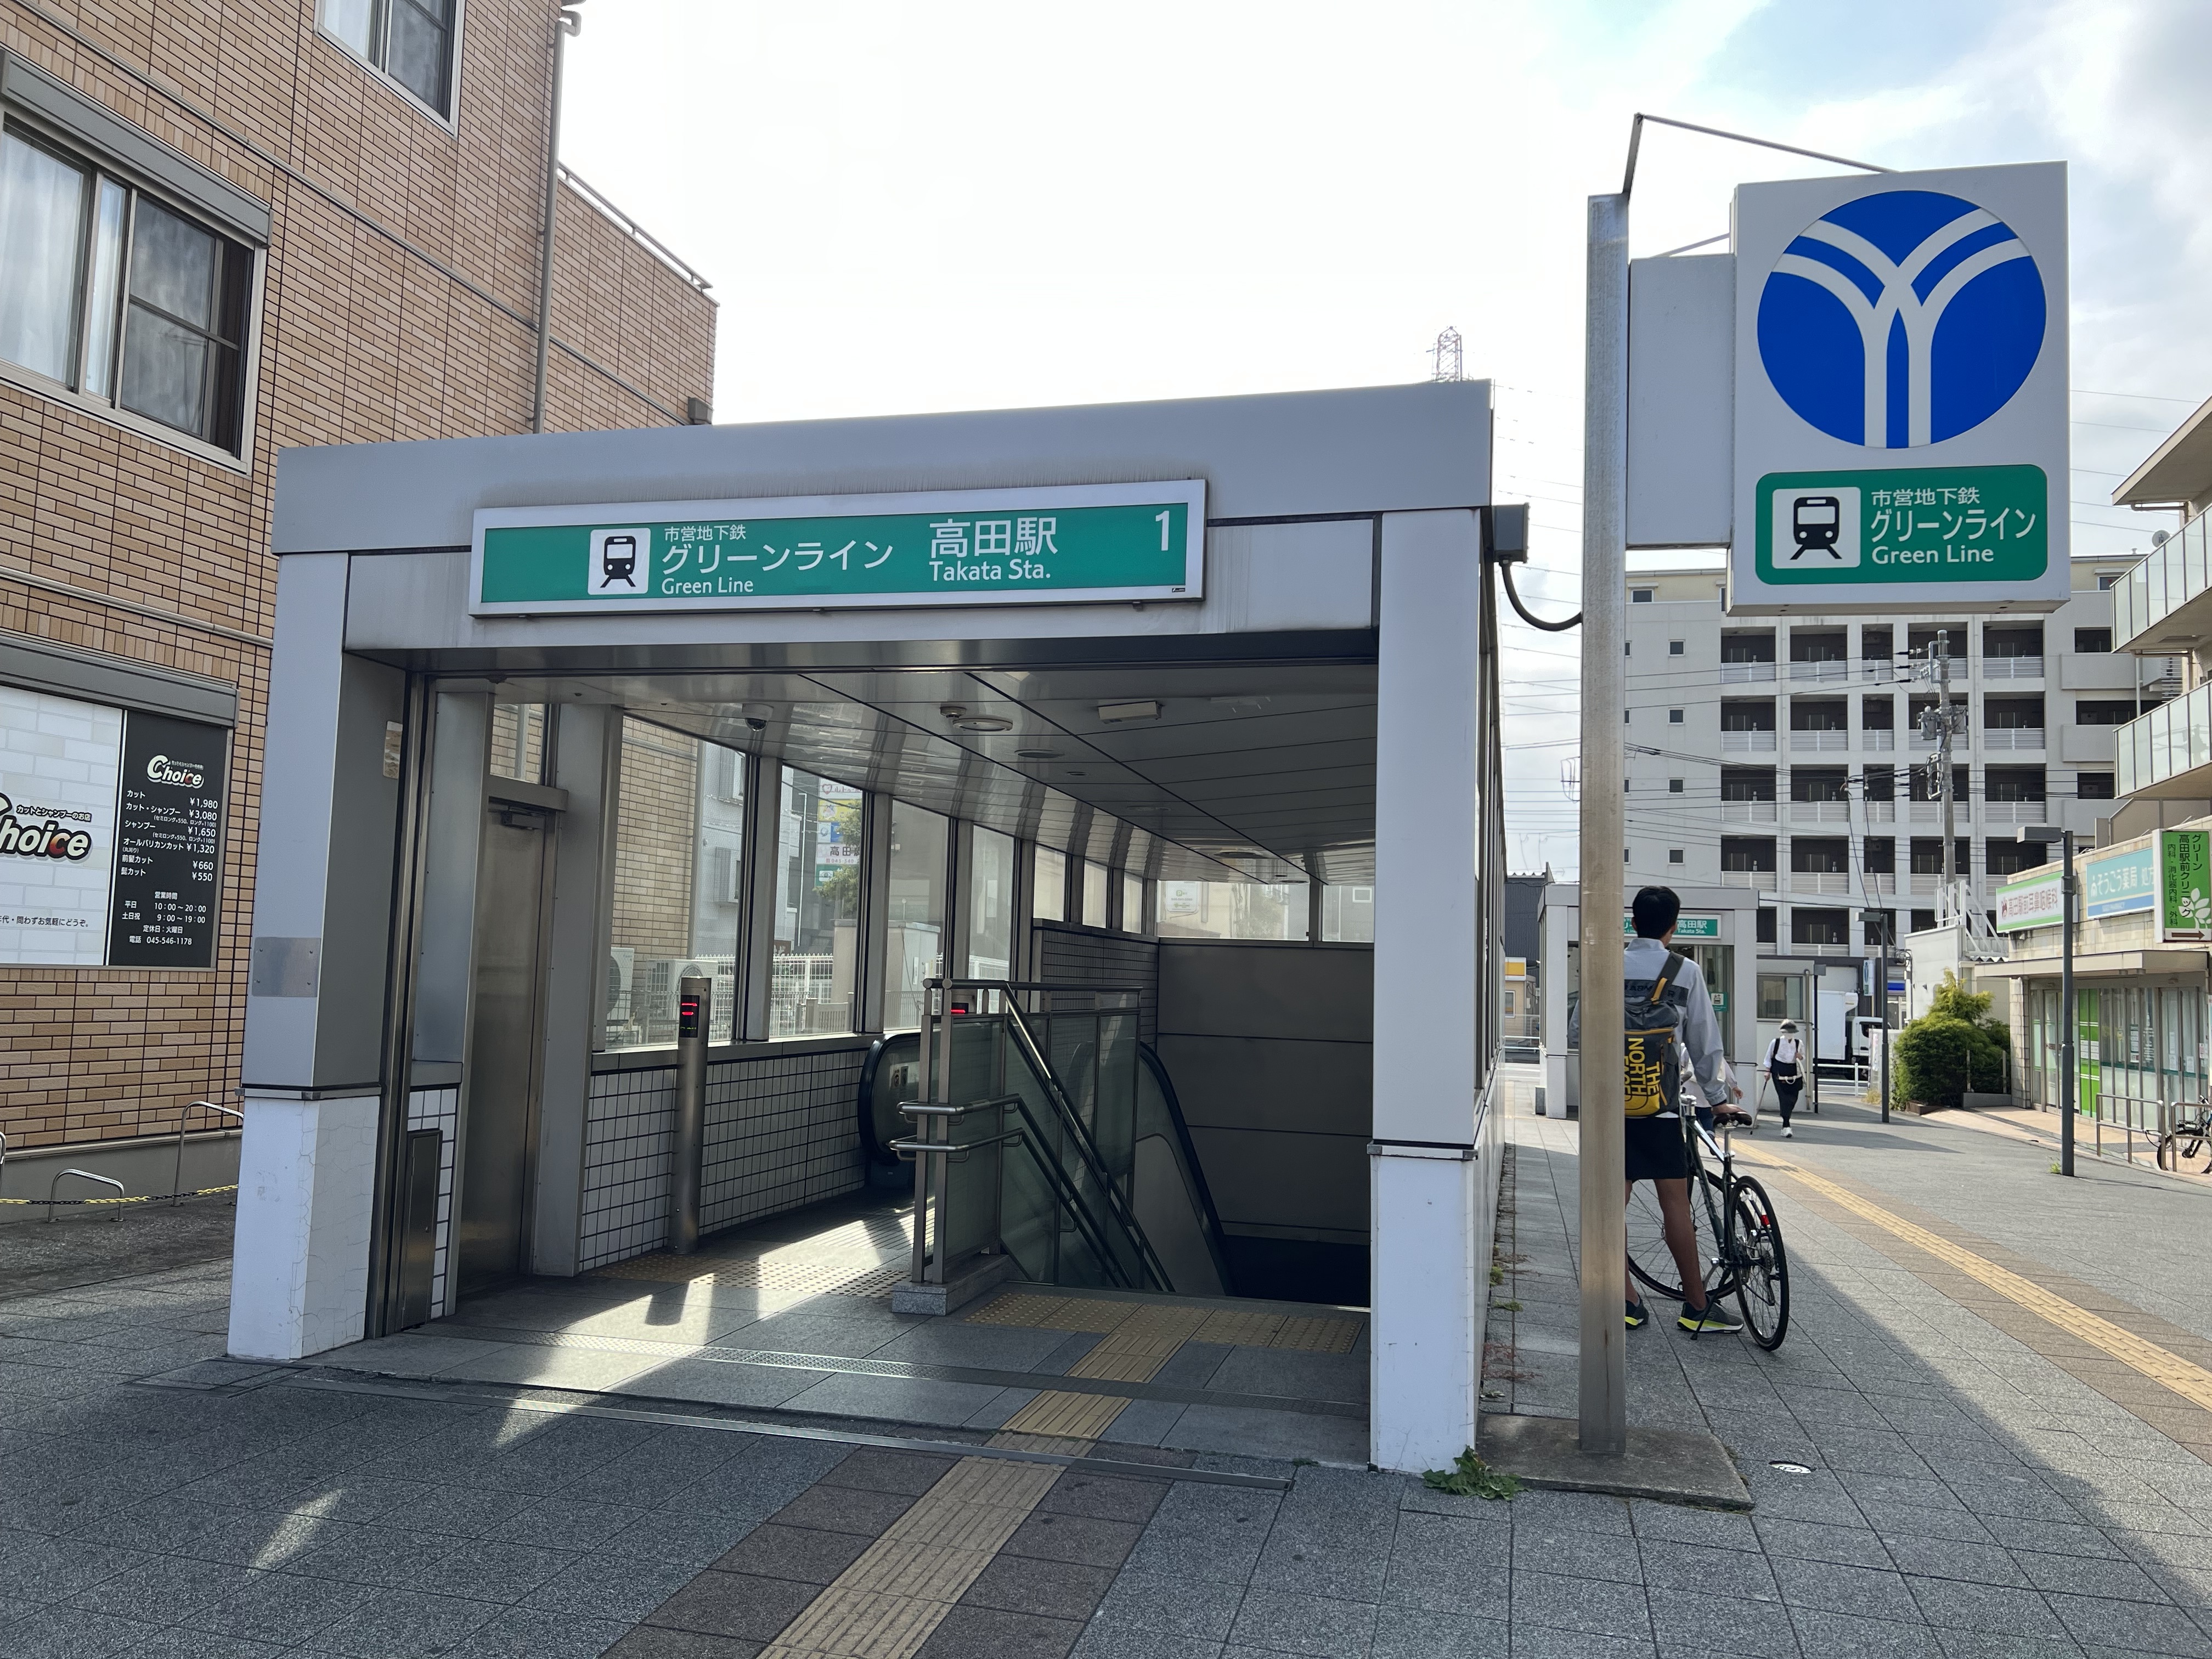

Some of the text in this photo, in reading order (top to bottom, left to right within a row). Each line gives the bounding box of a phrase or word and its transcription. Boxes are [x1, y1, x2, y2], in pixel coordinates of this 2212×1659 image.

[1871, 487, 1980, 507] 市営地下鉄
[664, 524, 746, 542] 市営地下鉄
[1155, 510, 1170, 551] 1
[1871, 507, 2036, 543] グリーンライン
[929, 517, 1058, 558] 高田駅
[662, 540, 893, 575] グリーンライン
[1872, 545, 1994, 565] Green Line
[929, 558, 1051, 582] Takata Sta.
[662, 577, 753, 594] Green Line
[147, 755, 204, 787] Choice
[127, 789, 218, 809] カット ¥1,980
[16, 805, 92, 822] カットとシャンプーのお店
[126, 802, 217, 821] カット・シャンプー ¥3,080
[125, 820, 216, 837] シャンプー ¥1,650
[123, 838, 215, 854] オールバリカンカット ¥1,320
[2192, 834, 2203, 871] グリーン
[122, 854, 153, 864] 前髪カット
[193, 861, 213, 871] ¥660
[192, 872, 213, 881] ¥550
[2168, 844, 2178, 926] 内科・消化器内科・外科
[2179, 834, 2191, 918] 高田駅前クリニック
[125, 900, 137, 909] 平日
[155, 891, 178, 900] 営業時間
[1677, 920, 1707, 929] 高田駅
[129, 935, 192, 945] 電話 045-546-1178
[1628, 1038, 1647, 1095] NORTH
[1646, 1061, 1661, 1095] THE
